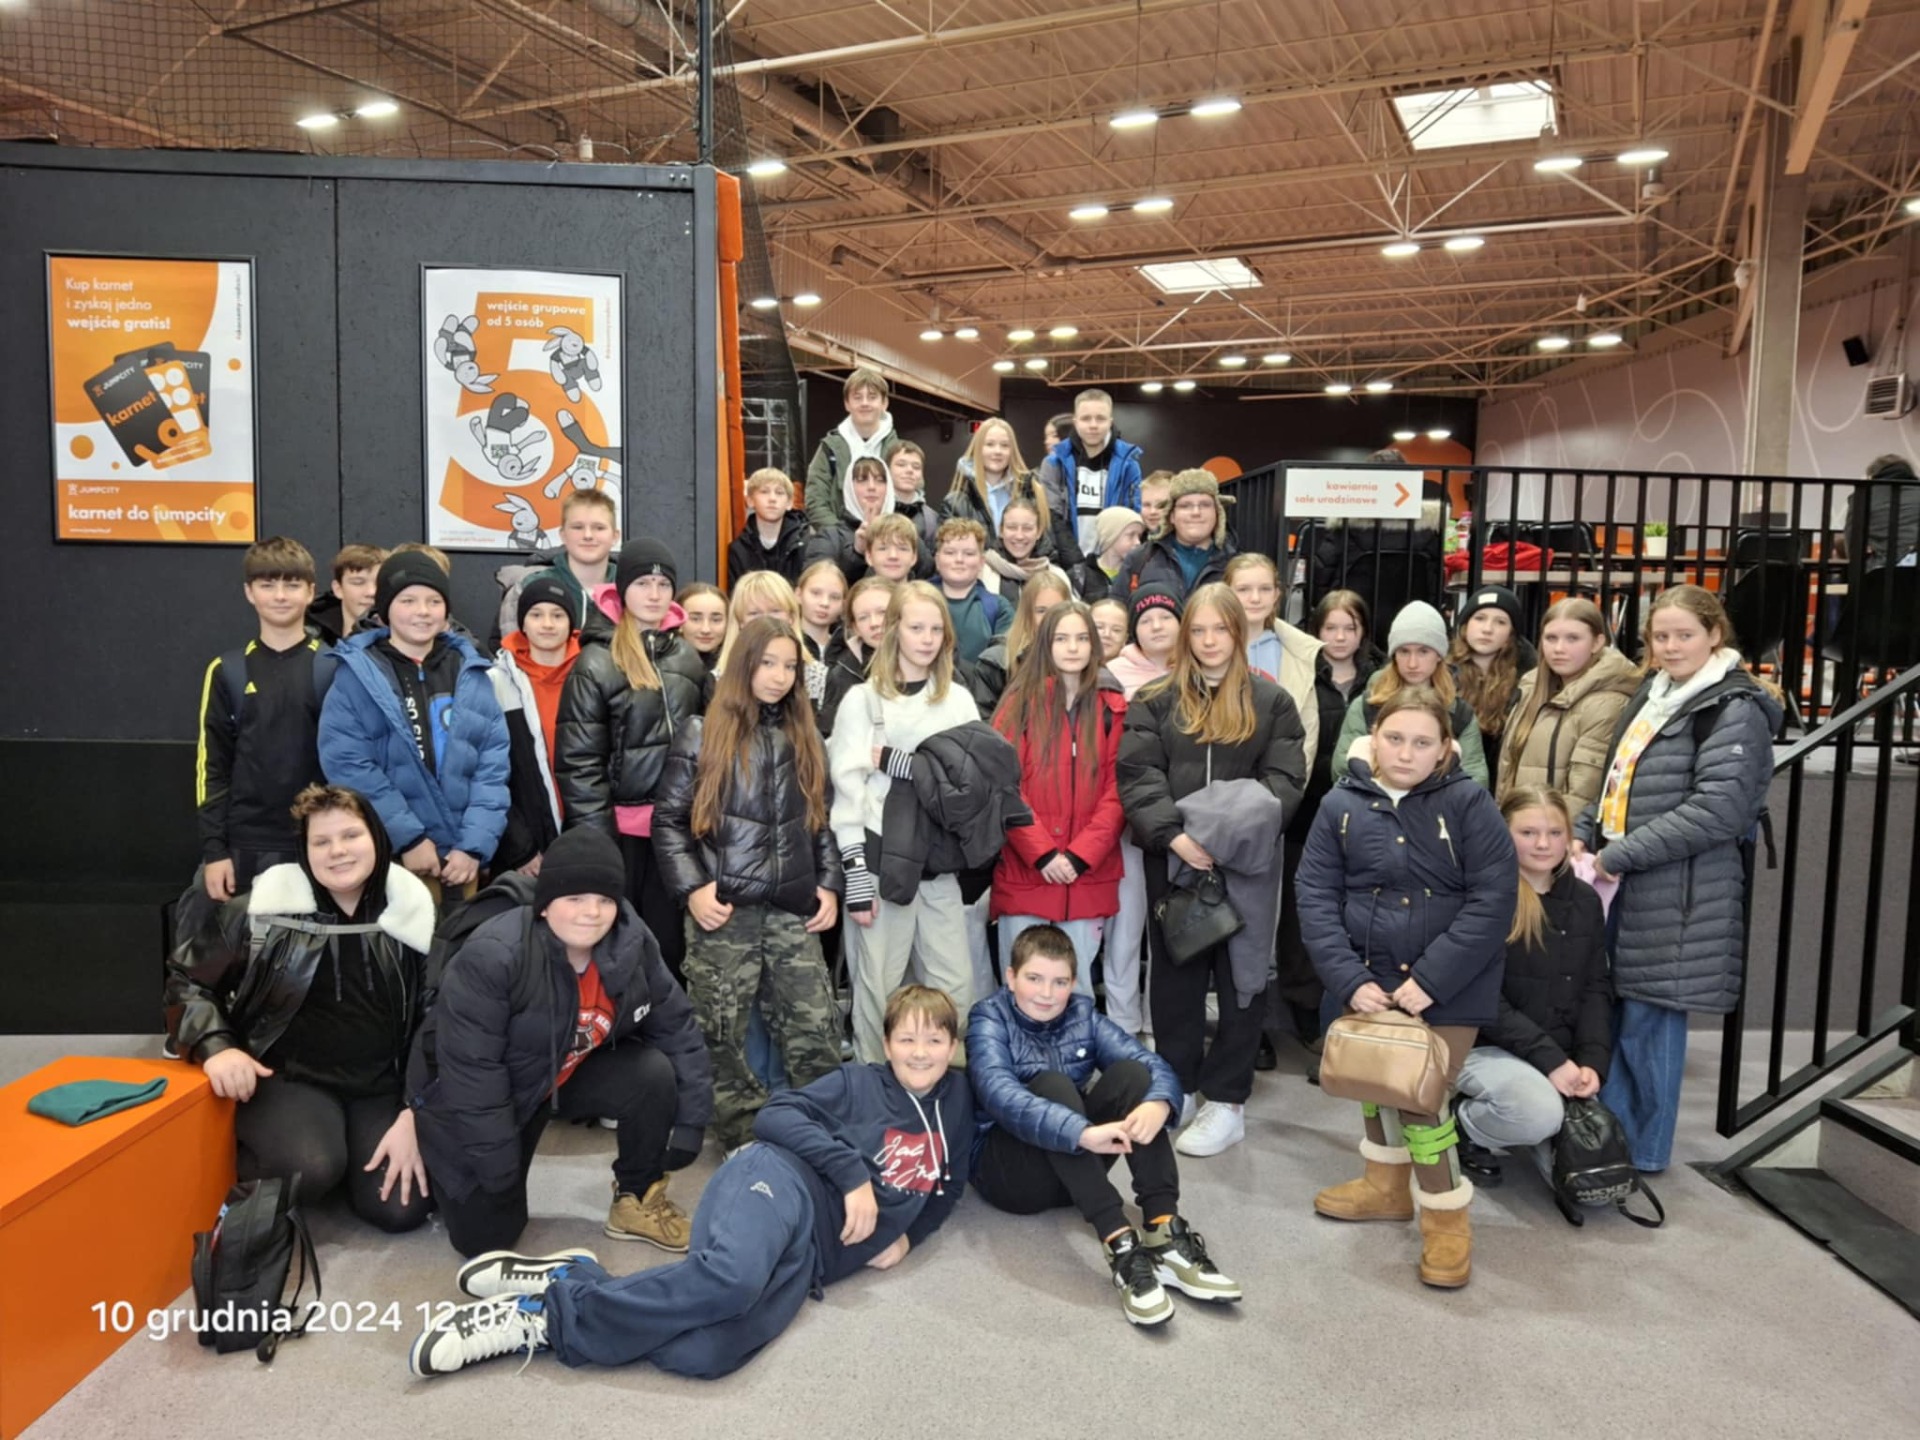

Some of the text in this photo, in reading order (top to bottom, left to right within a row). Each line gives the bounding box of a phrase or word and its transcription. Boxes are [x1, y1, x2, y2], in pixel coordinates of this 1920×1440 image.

[65, 277, 133, 293] Kup karnet
[66, 296, 152, 312] i zyskaj jedno
[486, 300, 586, 316] wejście grupowe
[67, 315, 171, 332] wejście gratis!
[486, 315, 544, 328] od 5 osób
[103, 366, 135, 390] JUMPCITY
[105, 390, 157, 426] karnet
[79, 486, 120, 494] JUMPCITY
[1326, 481, 1379, 491] kawiarnia
[1295, 494, 1377, 505] sale urodzinowe
[68, 504, 226, 525] karnet do jumpcity
